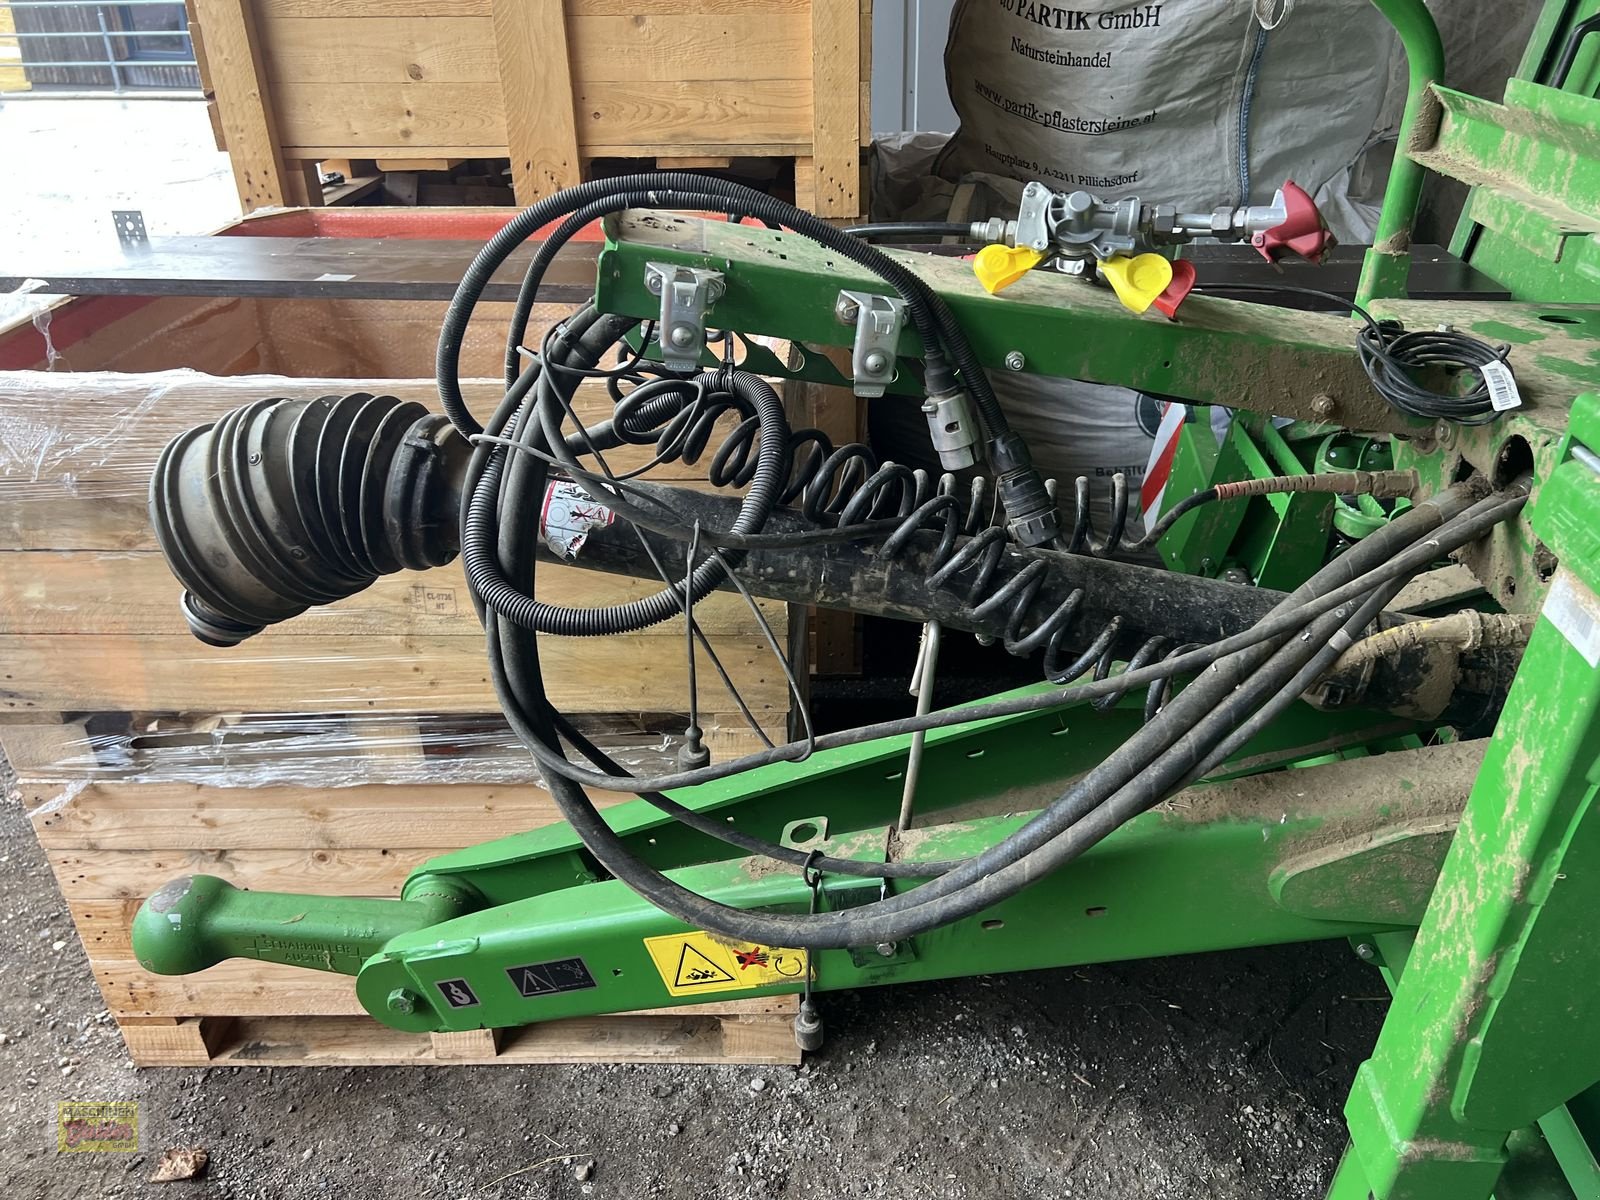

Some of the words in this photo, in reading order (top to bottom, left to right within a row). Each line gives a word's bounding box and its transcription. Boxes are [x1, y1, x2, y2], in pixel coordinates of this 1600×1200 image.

[1016, 0, 1091, 30] PARTIK
[1098, 5, 1162, 30] GmbH
[1011, 36, 1111, 68] Natursteinhandel
[974, 79, 1158, 135] www.partik-pflastersteine.at
[985, 144, 1030, 170] Hauptplatz
[1032, 162, 1041, 175] 9,
[1043, 169, 1075, 184] A-2211
[1078, 171, 1138, 188] Pillichsdorf
